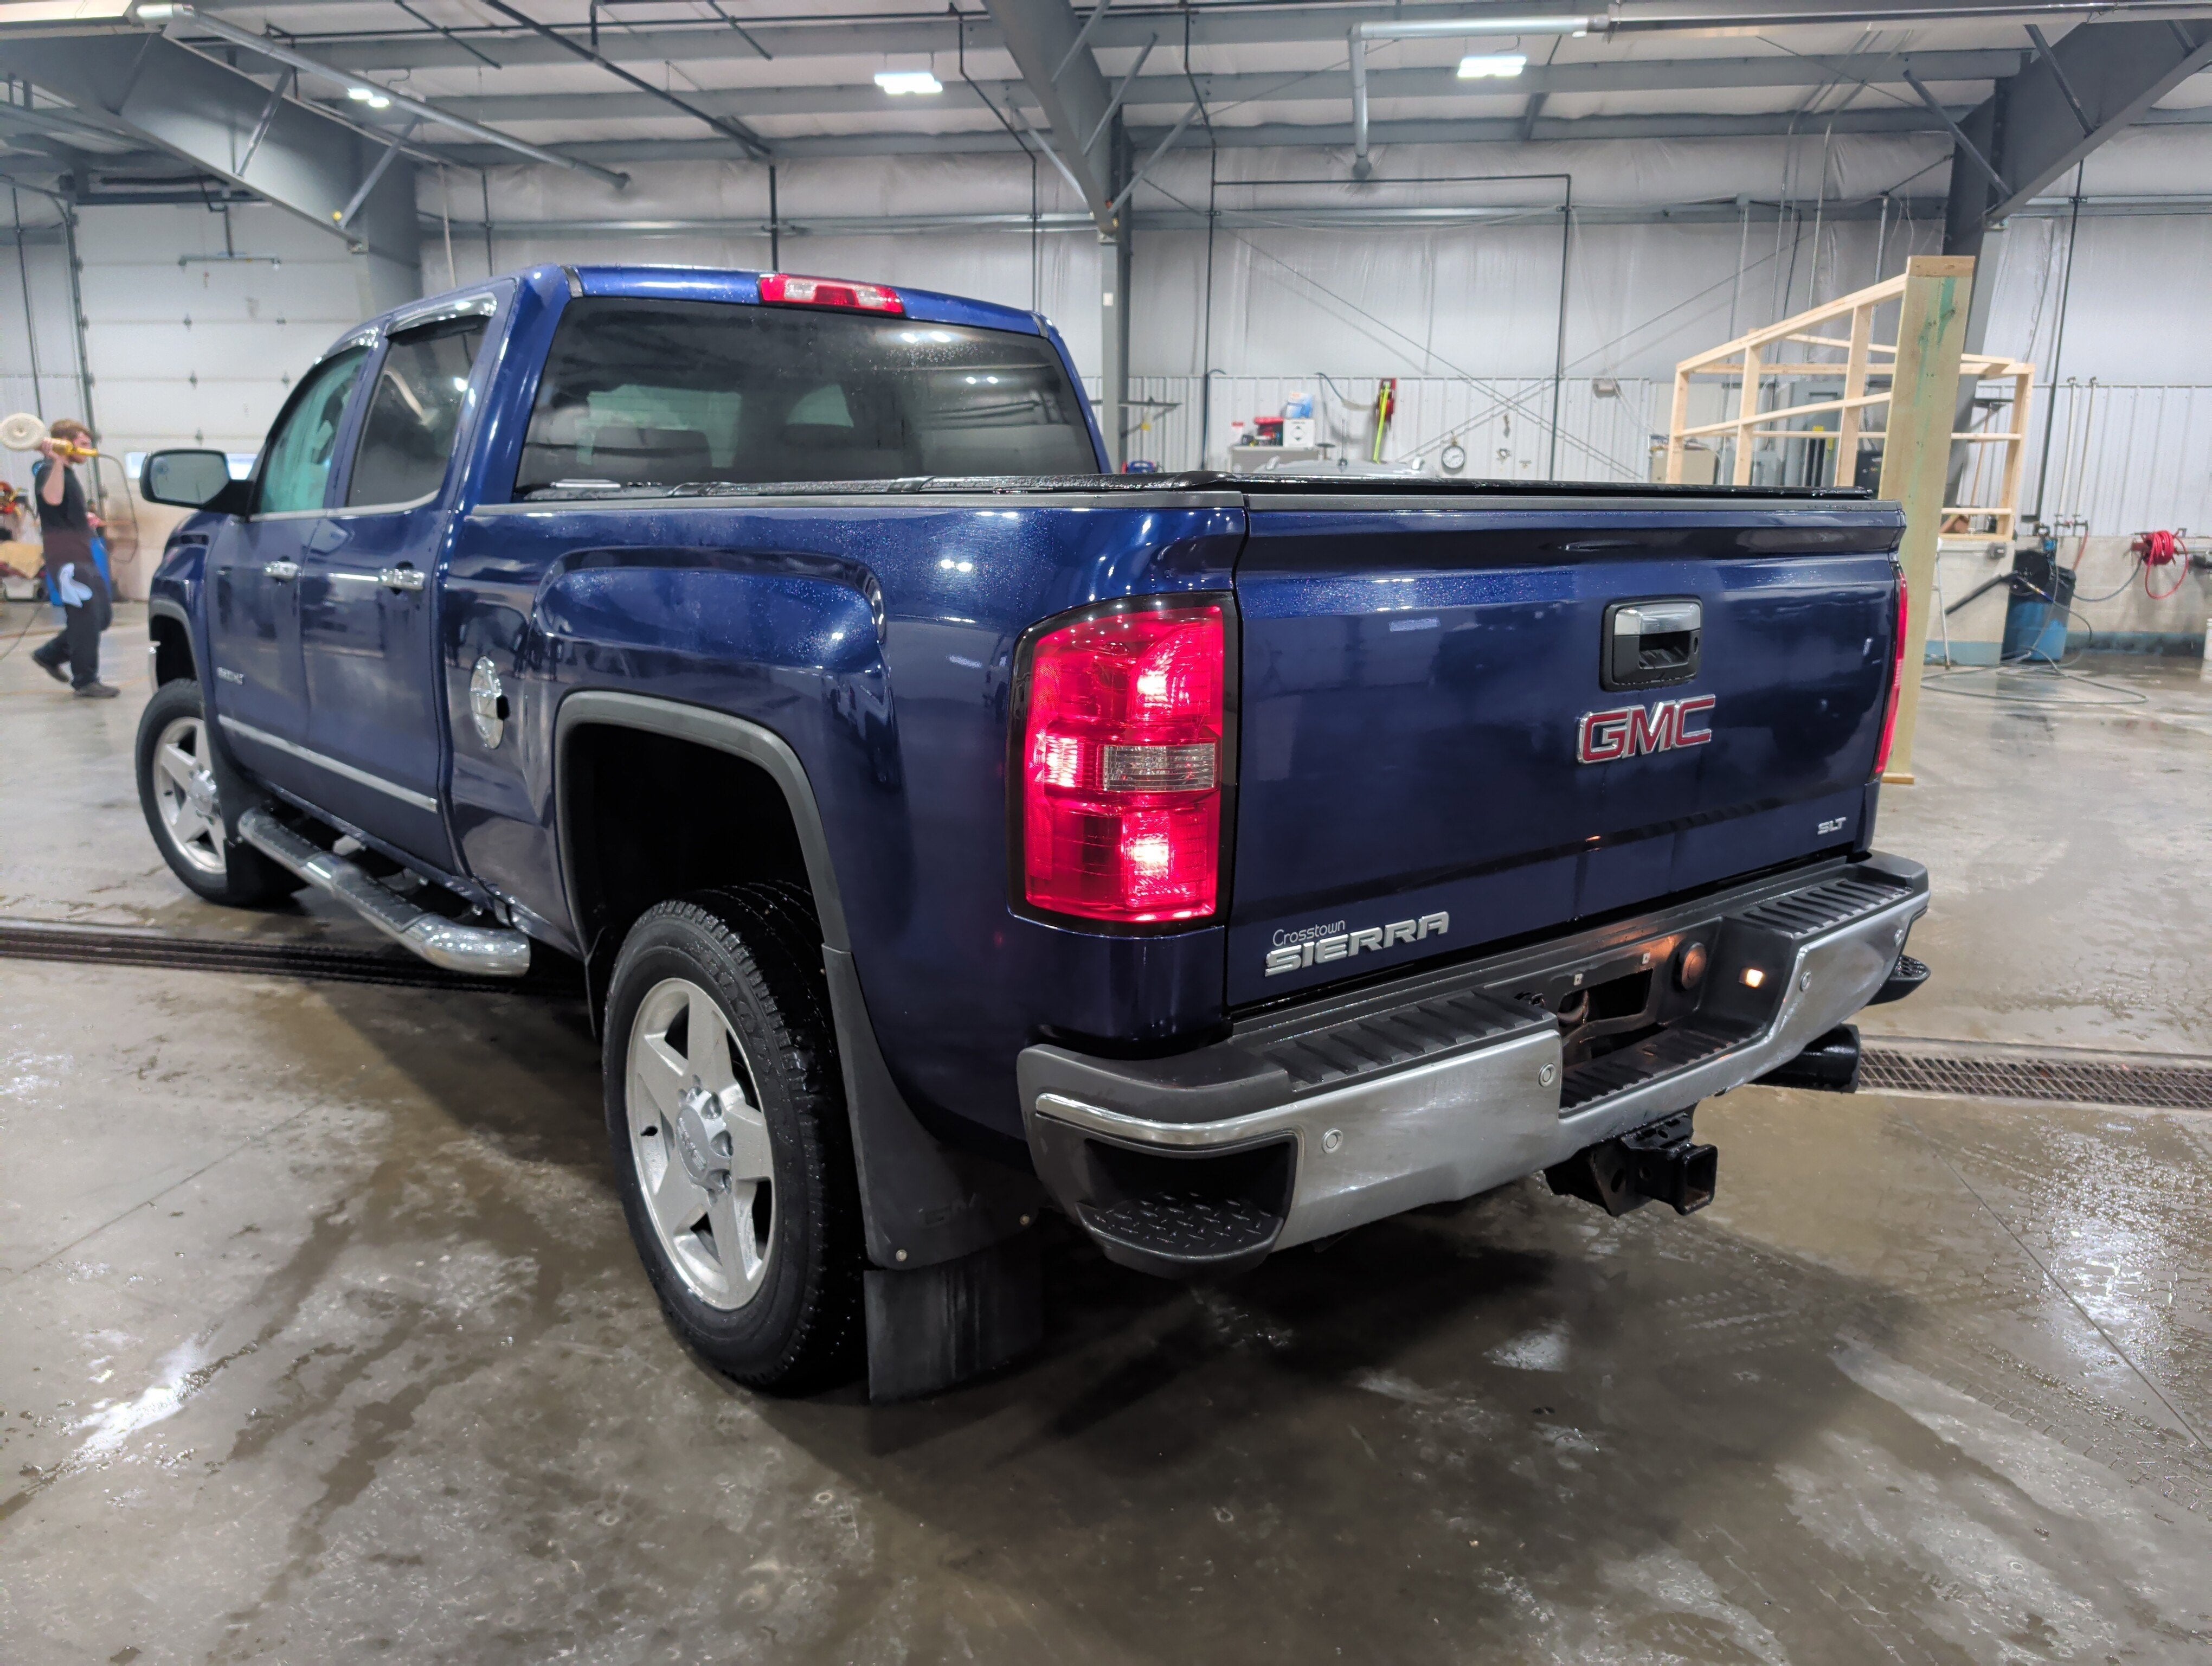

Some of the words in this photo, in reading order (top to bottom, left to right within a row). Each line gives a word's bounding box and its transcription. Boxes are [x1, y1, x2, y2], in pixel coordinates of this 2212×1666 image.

[1577, 694, 1715, 764] GMC
[1817, 817, 1846, 835] SLT
[1265, 911, 1450, 977] SIERRA
[1272, 920, 1345, 946] Crosstown
